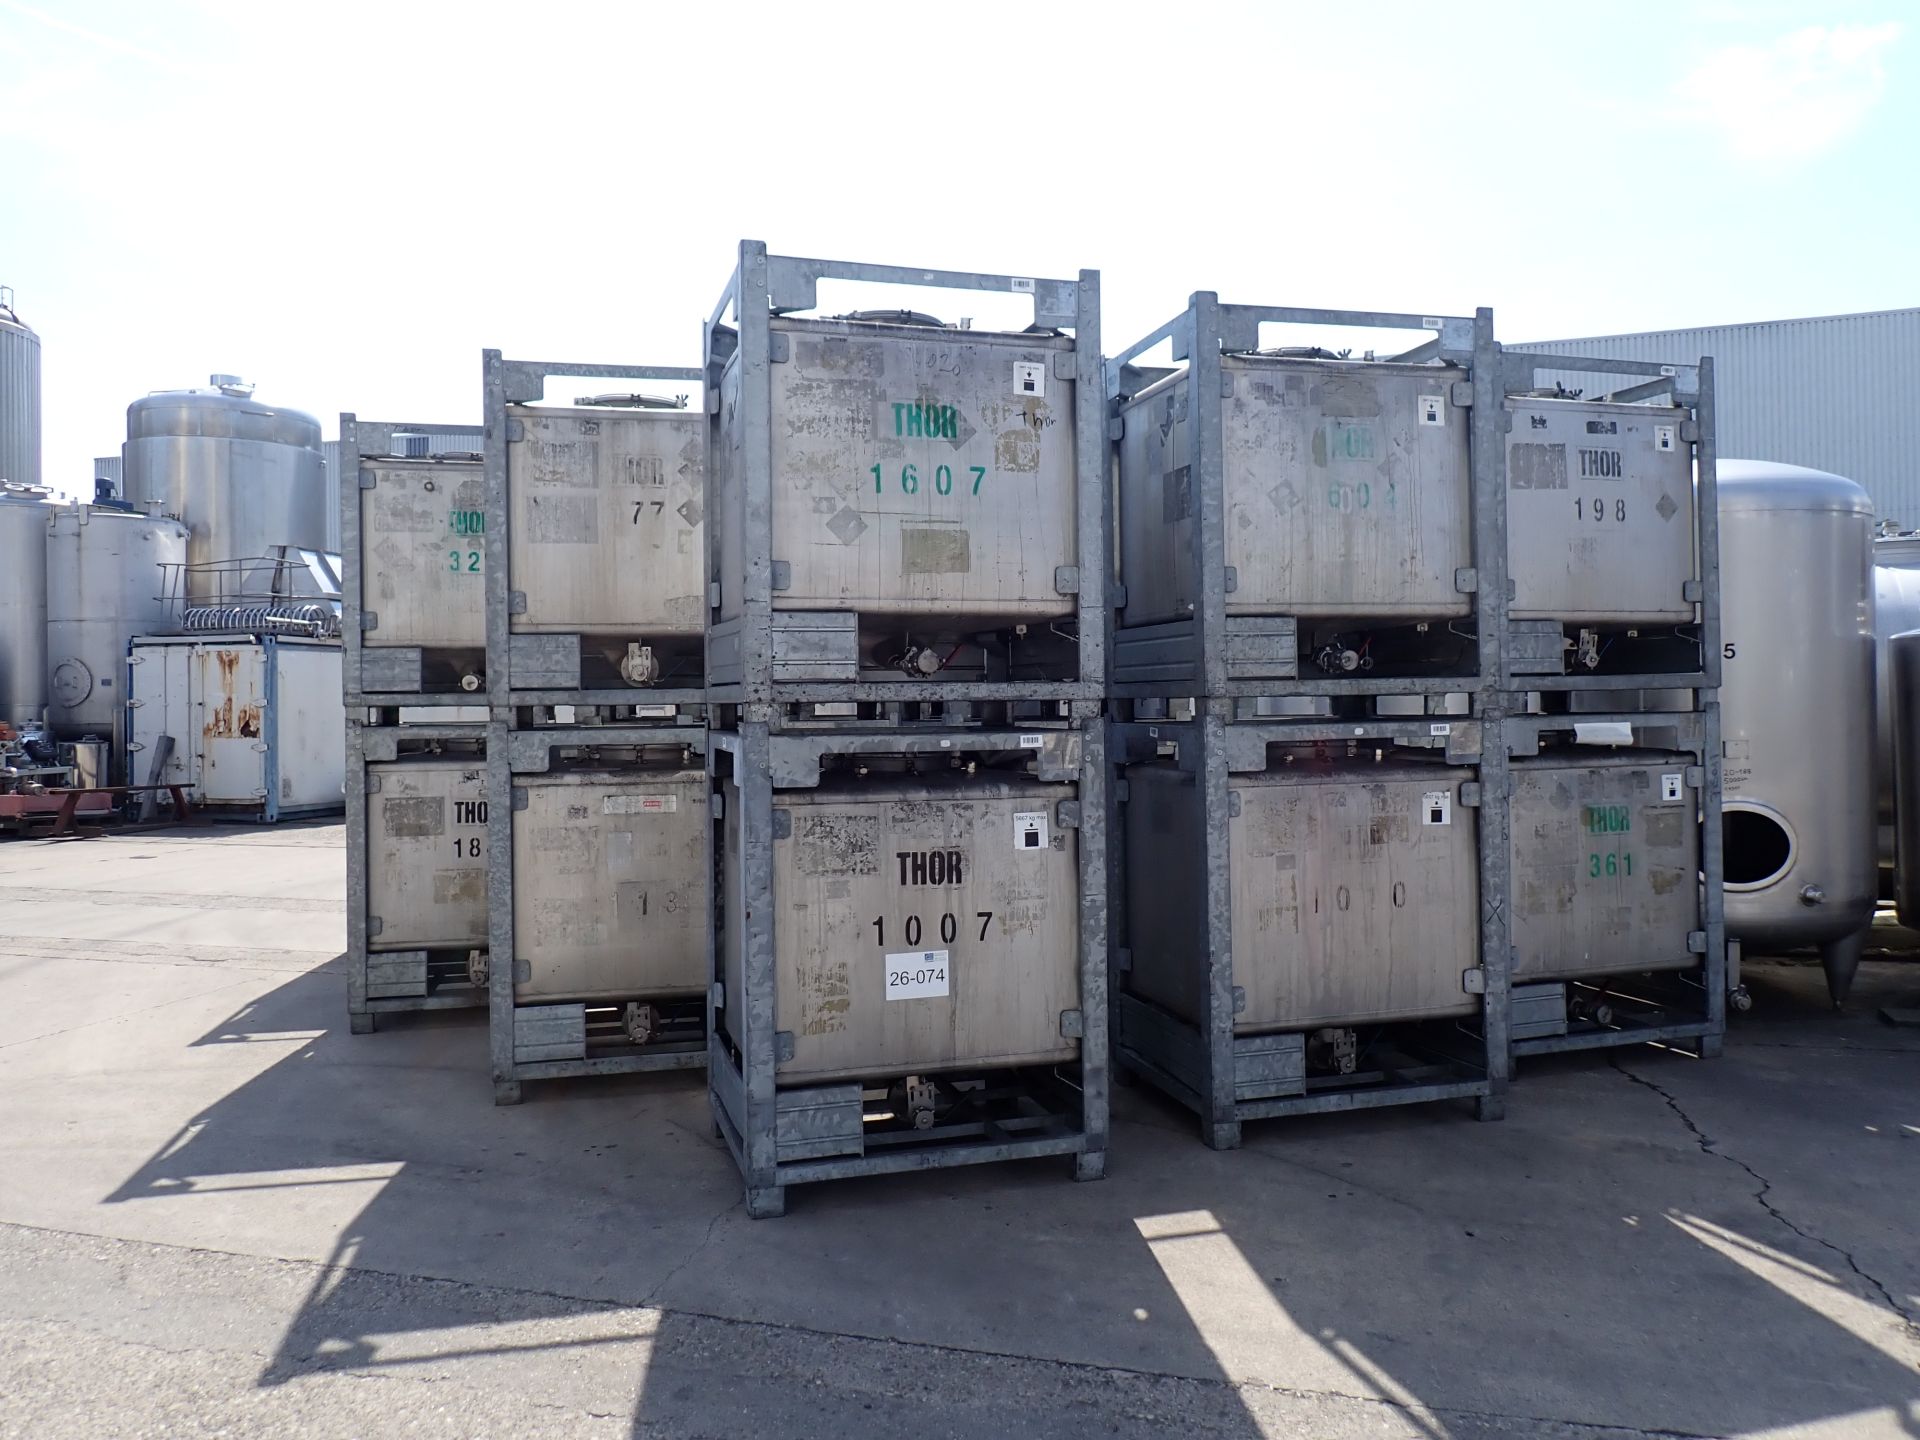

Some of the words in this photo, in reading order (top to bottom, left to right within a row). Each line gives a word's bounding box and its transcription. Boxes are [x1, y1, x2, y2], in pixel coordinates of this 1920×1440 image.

[891, 402, 958, 439] THOR
[1578, 449, 1622, 478] THOR
[869, 463, 987, 497] 1607
[1574, 497, 1627, 523] 198
[449, 550, 488, 572] 32
[453, 801, 488, 824] THO
[1585, 805, 1631, 833] THOR
[453, 838, 489, 858] 18
[896, 850, 962, 886] THOR
[1589, 852, 1632, 877] 361
[872, 911, 993, 947] 1007
[890, 968, 946, 987] 26-074
